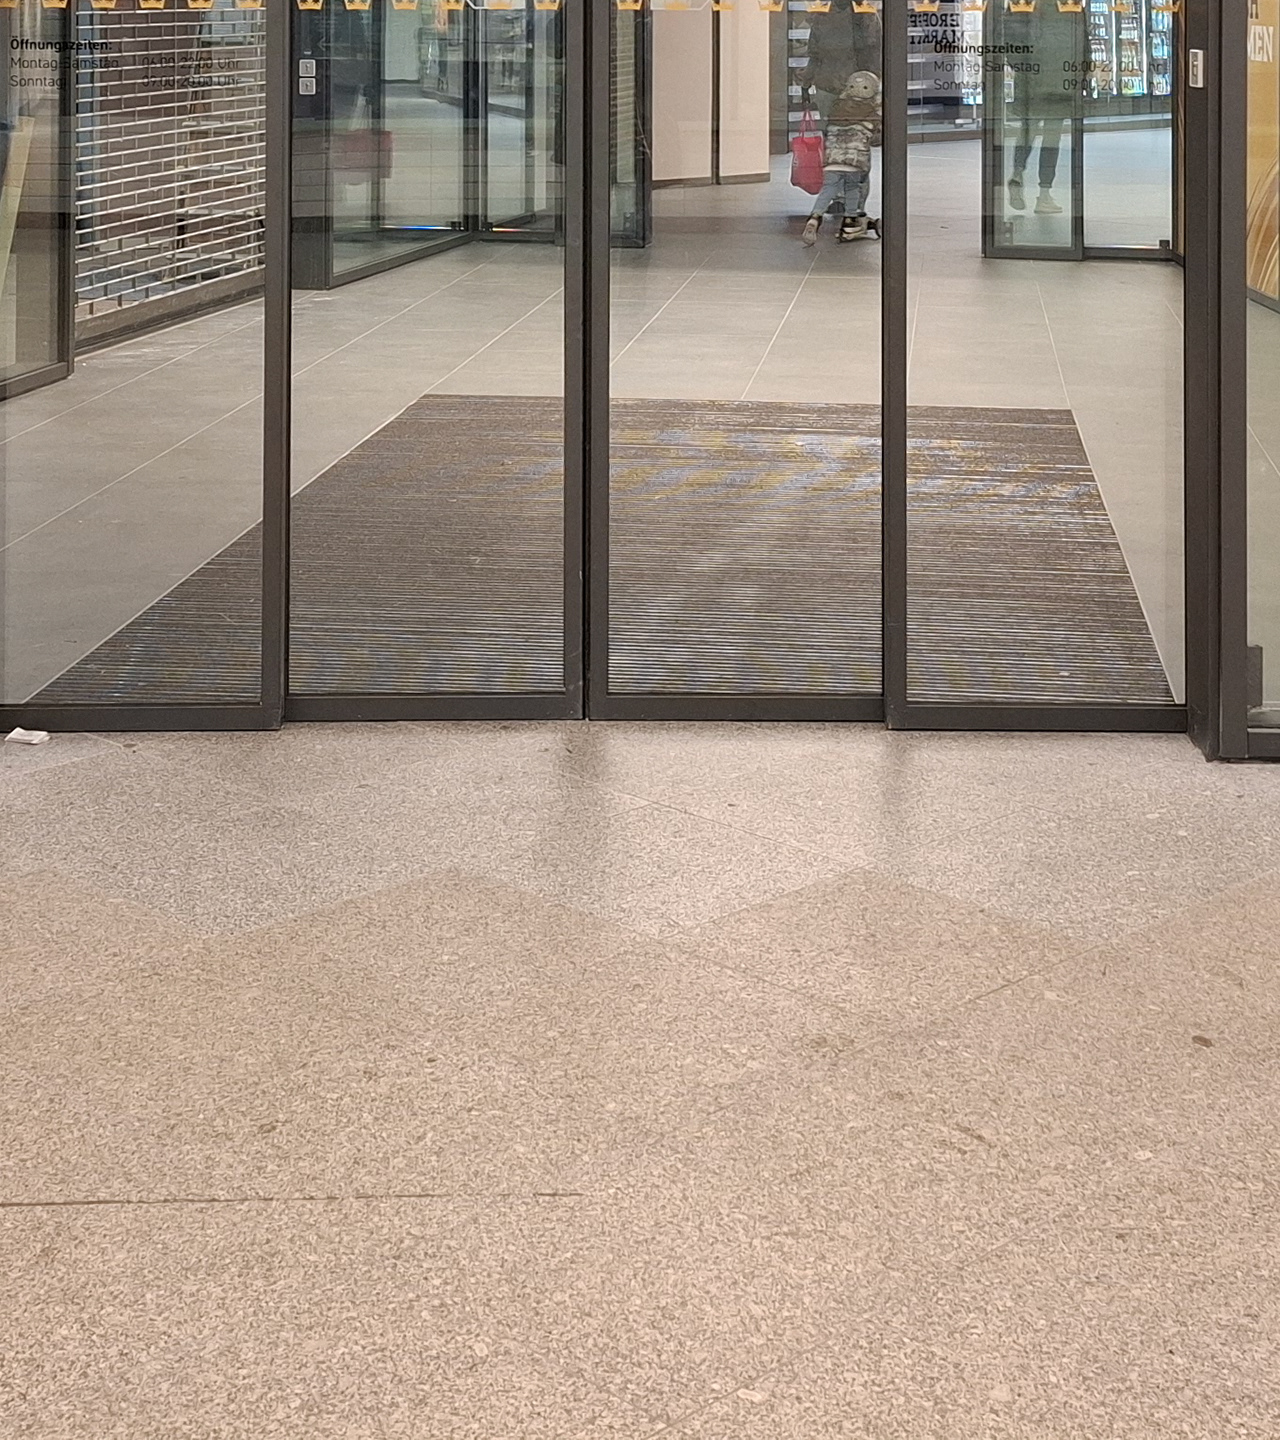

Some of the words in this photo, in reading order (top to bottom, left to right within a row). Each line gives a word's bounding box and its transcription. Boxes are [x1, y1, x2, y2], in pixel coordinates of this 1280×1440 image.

[10, 35, 113, 54] Öffnungszeiten:
[934, 40, 1035, 56] Öffnungszeiten:
[217, 57, 241, 69] Uhr
[933, 61, 1041, 75] Montag-Samstag
[1062, 60, 1133, 73] 06:00-2200
[10, 74, 67, 90] Sonntag
[217, 75, 242, 88] Uhr
[933, 78, 987, 92] Sonntag
[1137, 79, 1162, 91] hr
